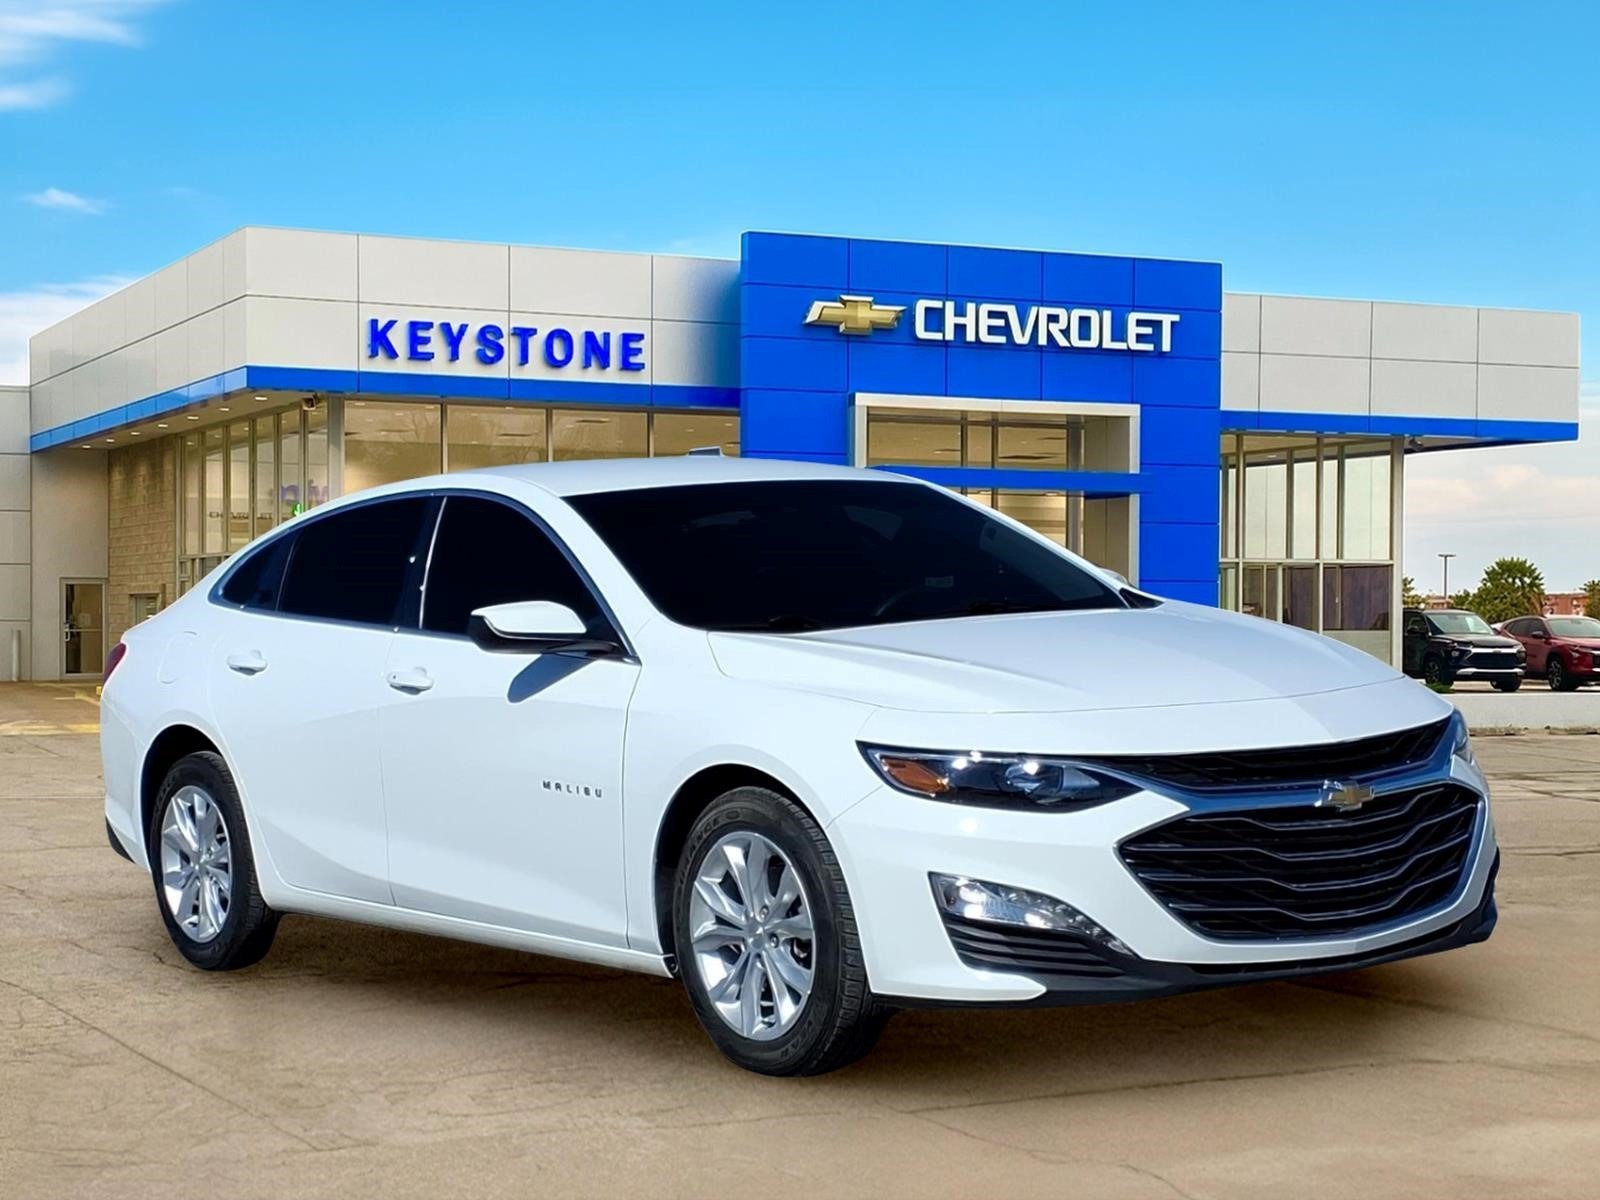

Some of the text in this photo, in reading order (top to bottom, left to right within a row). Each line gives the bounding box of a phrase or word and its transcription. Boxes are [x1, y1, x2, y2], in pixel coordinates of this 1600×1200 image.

[368, 318, 646, 371] KEYSTONE
[914, 299, 1181, 352] CHEVROLET
[542, 780, 602, 798] MALIBU
